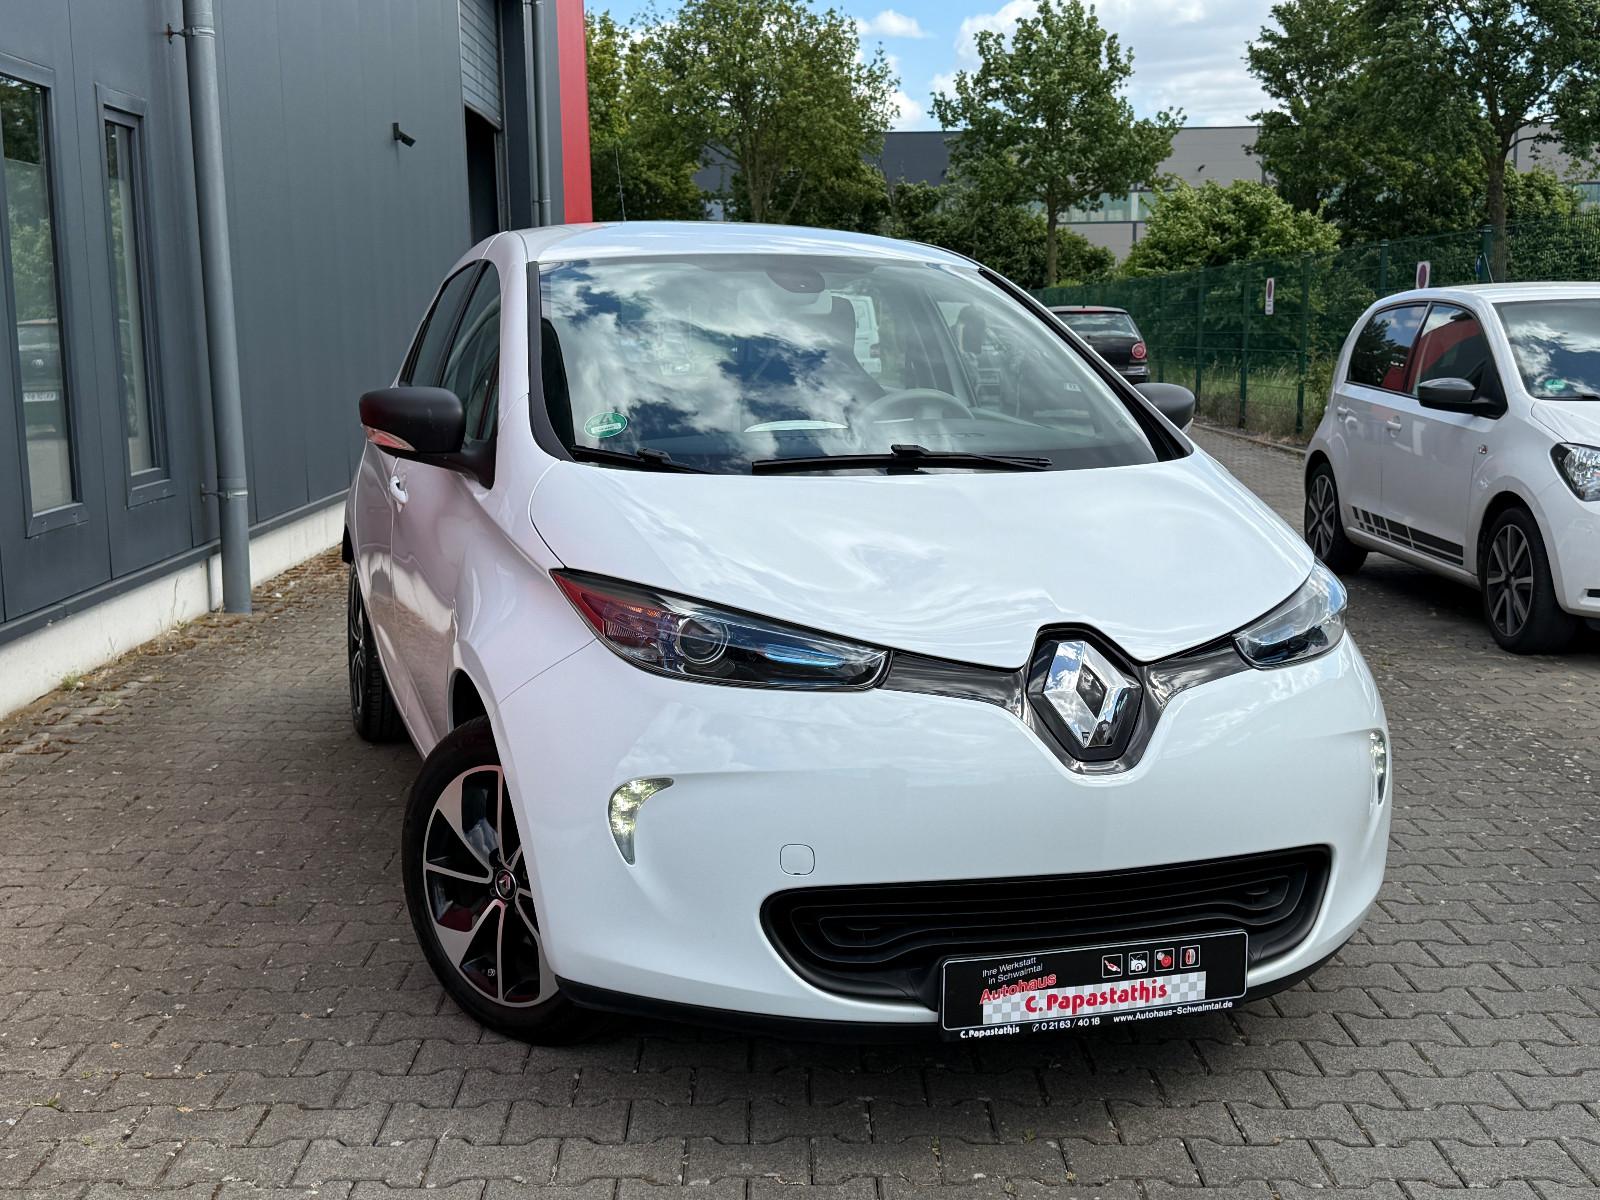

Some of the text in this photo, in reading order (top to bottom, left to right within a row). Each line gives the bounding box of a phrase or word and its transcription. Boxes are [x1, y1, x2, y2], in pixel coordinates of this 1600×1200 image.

[982, 957, 1037, 978] Ihre Werkstatt
[988, 963, 1043, 985] in Schwalmtal
[979, 973, 1057, 1005] Autohaus
[1113, 1000, 1233, 1023] www.Autohaus-Schwalmtal.de
